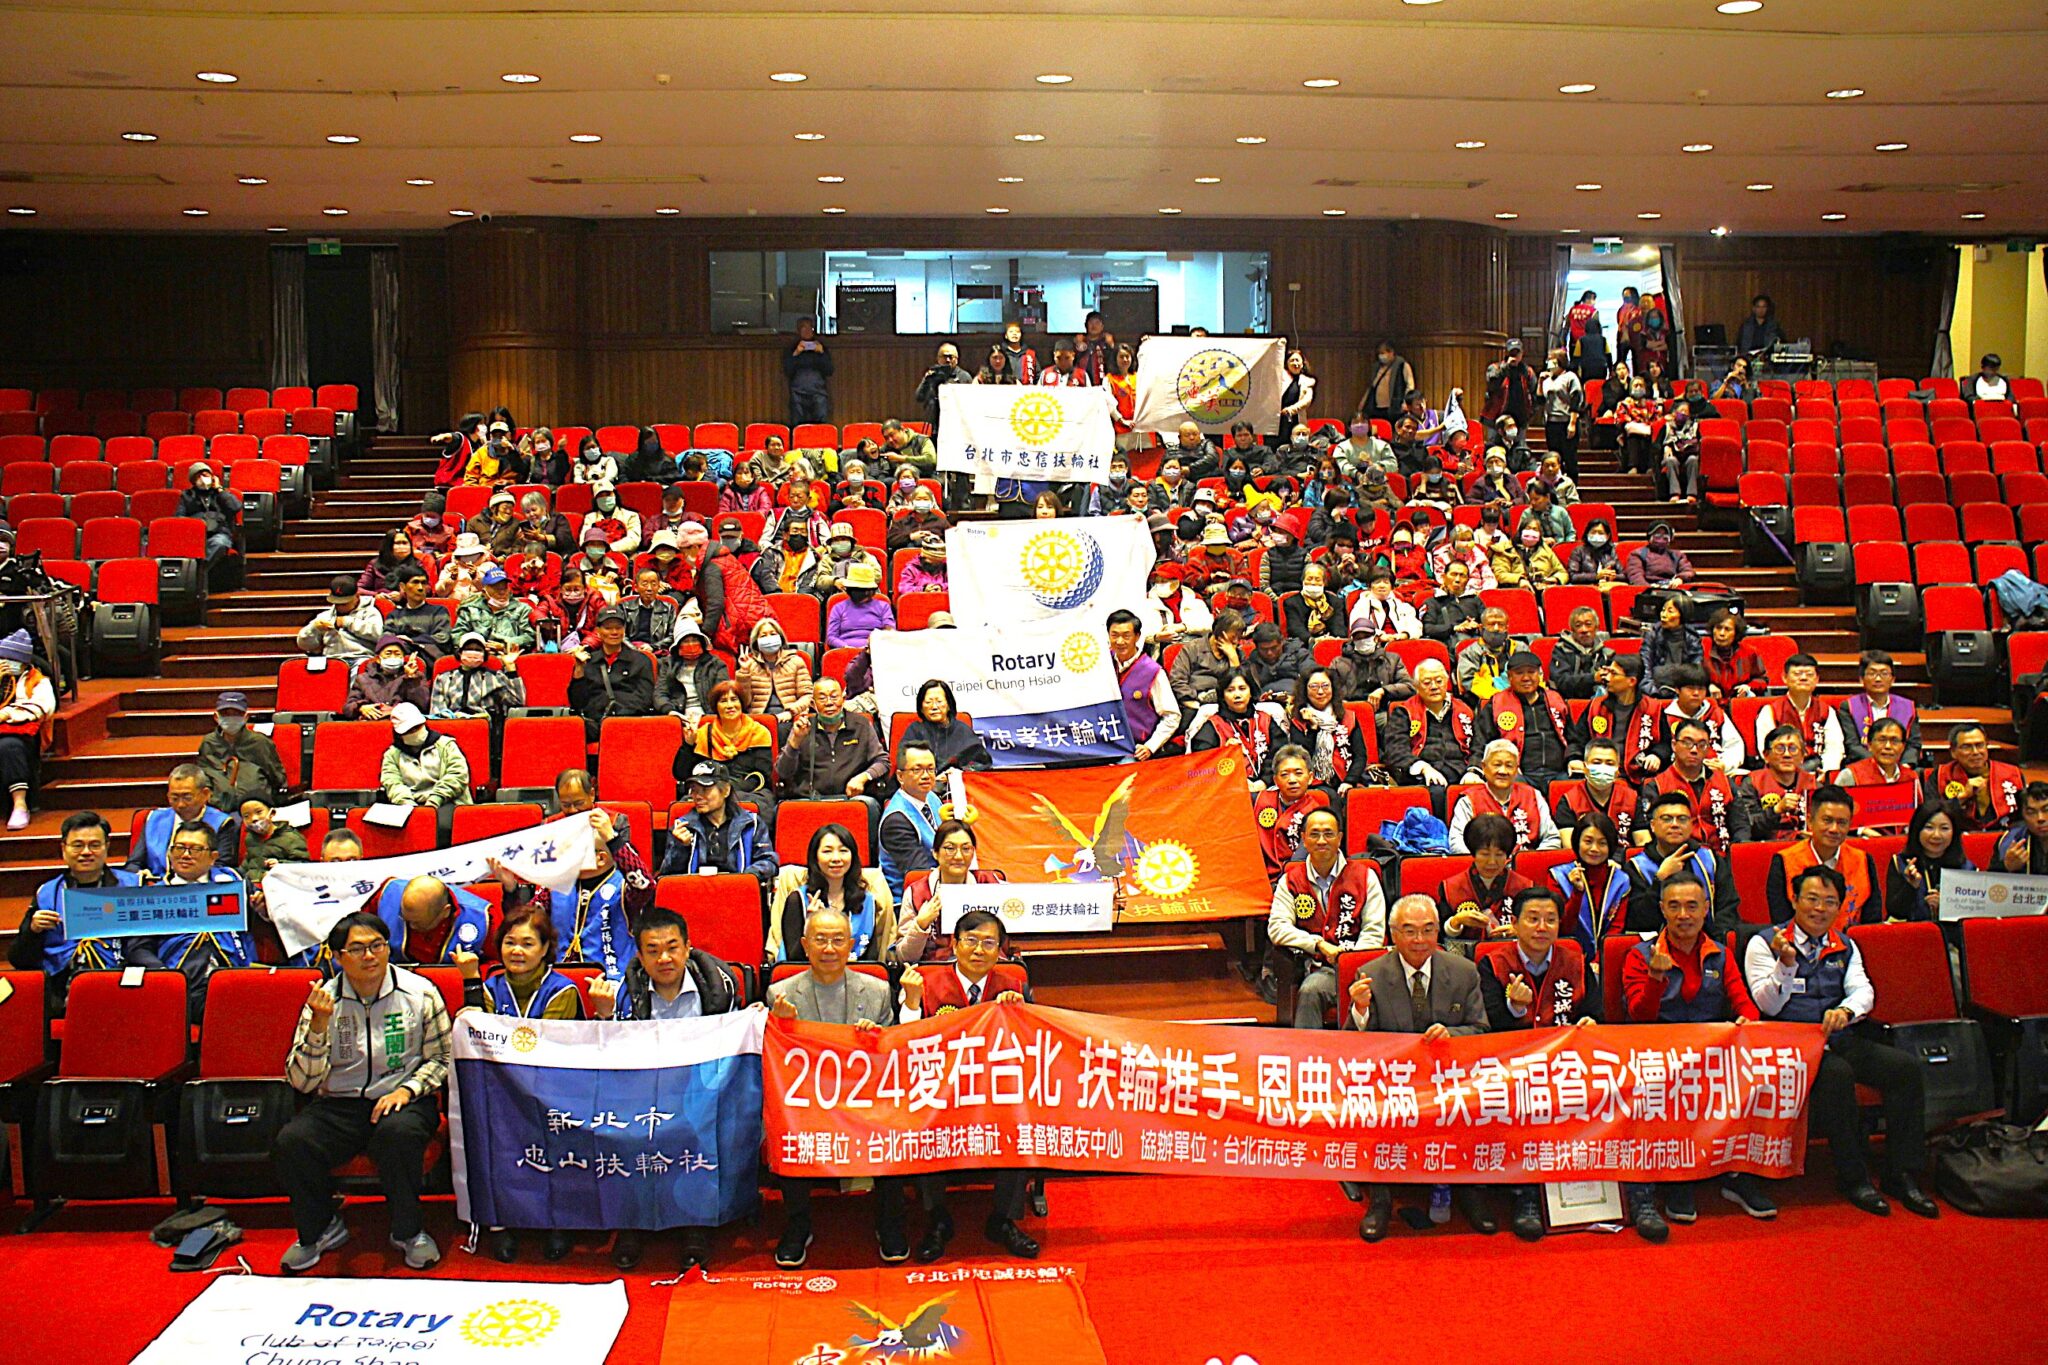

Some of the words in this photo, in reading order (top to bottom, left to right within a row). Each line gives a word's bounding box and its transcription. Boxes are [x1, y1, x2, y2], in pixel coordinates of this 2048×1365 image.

[965, 444, 1099, 469] 台北市忠信扶輪社
[991, 652, 1056, 672] Rotary
[948, 680, 983, 693] Taipei
[986, 678, 1025, 691] Chung
[1028, 674, 1061, 687] Hsiao
[1955, 886, 1987, 898] Rotary
[1031, 903, 1100, 917] 忠愛扶輪社
[468, 1026, 508, 1045] Rotary
[783, 1027, 1062, 1113] 2024愛在台北
[1431, 1045, 1808, 1127] 扶貧福貧永續特別活動
[547, 1106, 675, 1141] 新北市
[516, 1144, 719, 1178] 忠山扶輪社
[752, 1281, 802, 1290] Rotary
[294, 1303, 454, 1334] Rotary
[240, 1333, 305, 1348] Club
[356, 1336, 438, 1353] Taipei
